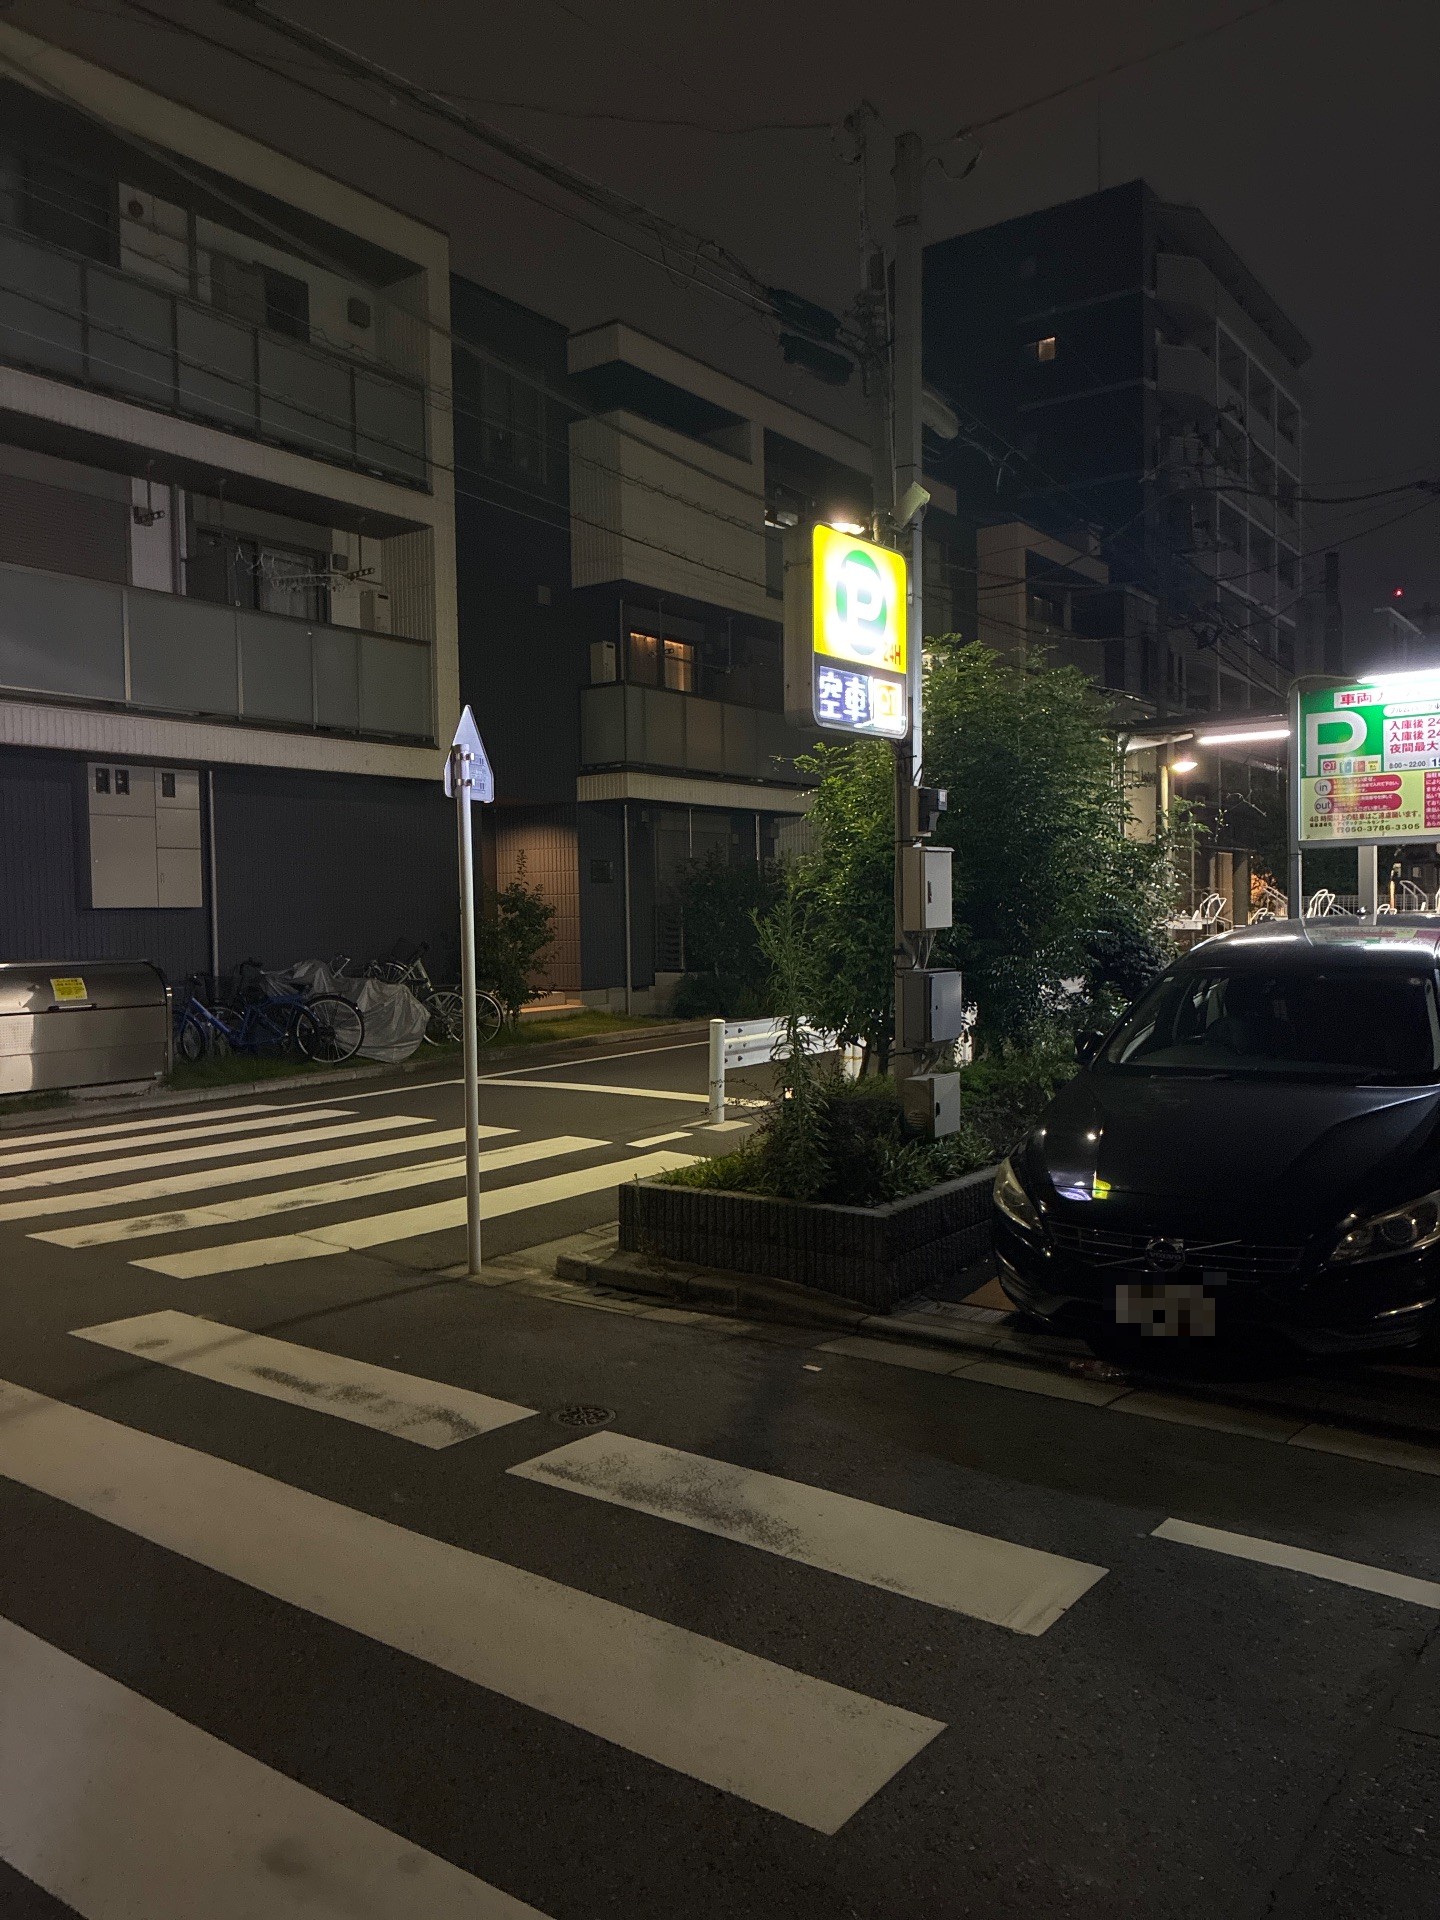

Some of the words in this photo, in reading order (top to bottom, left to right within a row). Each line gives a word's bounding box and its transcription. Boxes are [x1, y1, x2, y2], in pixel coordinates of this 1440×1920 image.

[845, 559, 884, 647] P
[819, 671, 868, 721] 空車
[1390, 719, 1424, 731] 入庫後
[1390, 730, 1424, 742] 入庫後
[1305, 710, 1368, 777] P
[1390, 740, 1439, 754] 夜間最大
[1319, 784, 1328, 792] in
[1315, 802, 1331, 810] out
[1345, 822, 1420, 833] 050-3786-3305
